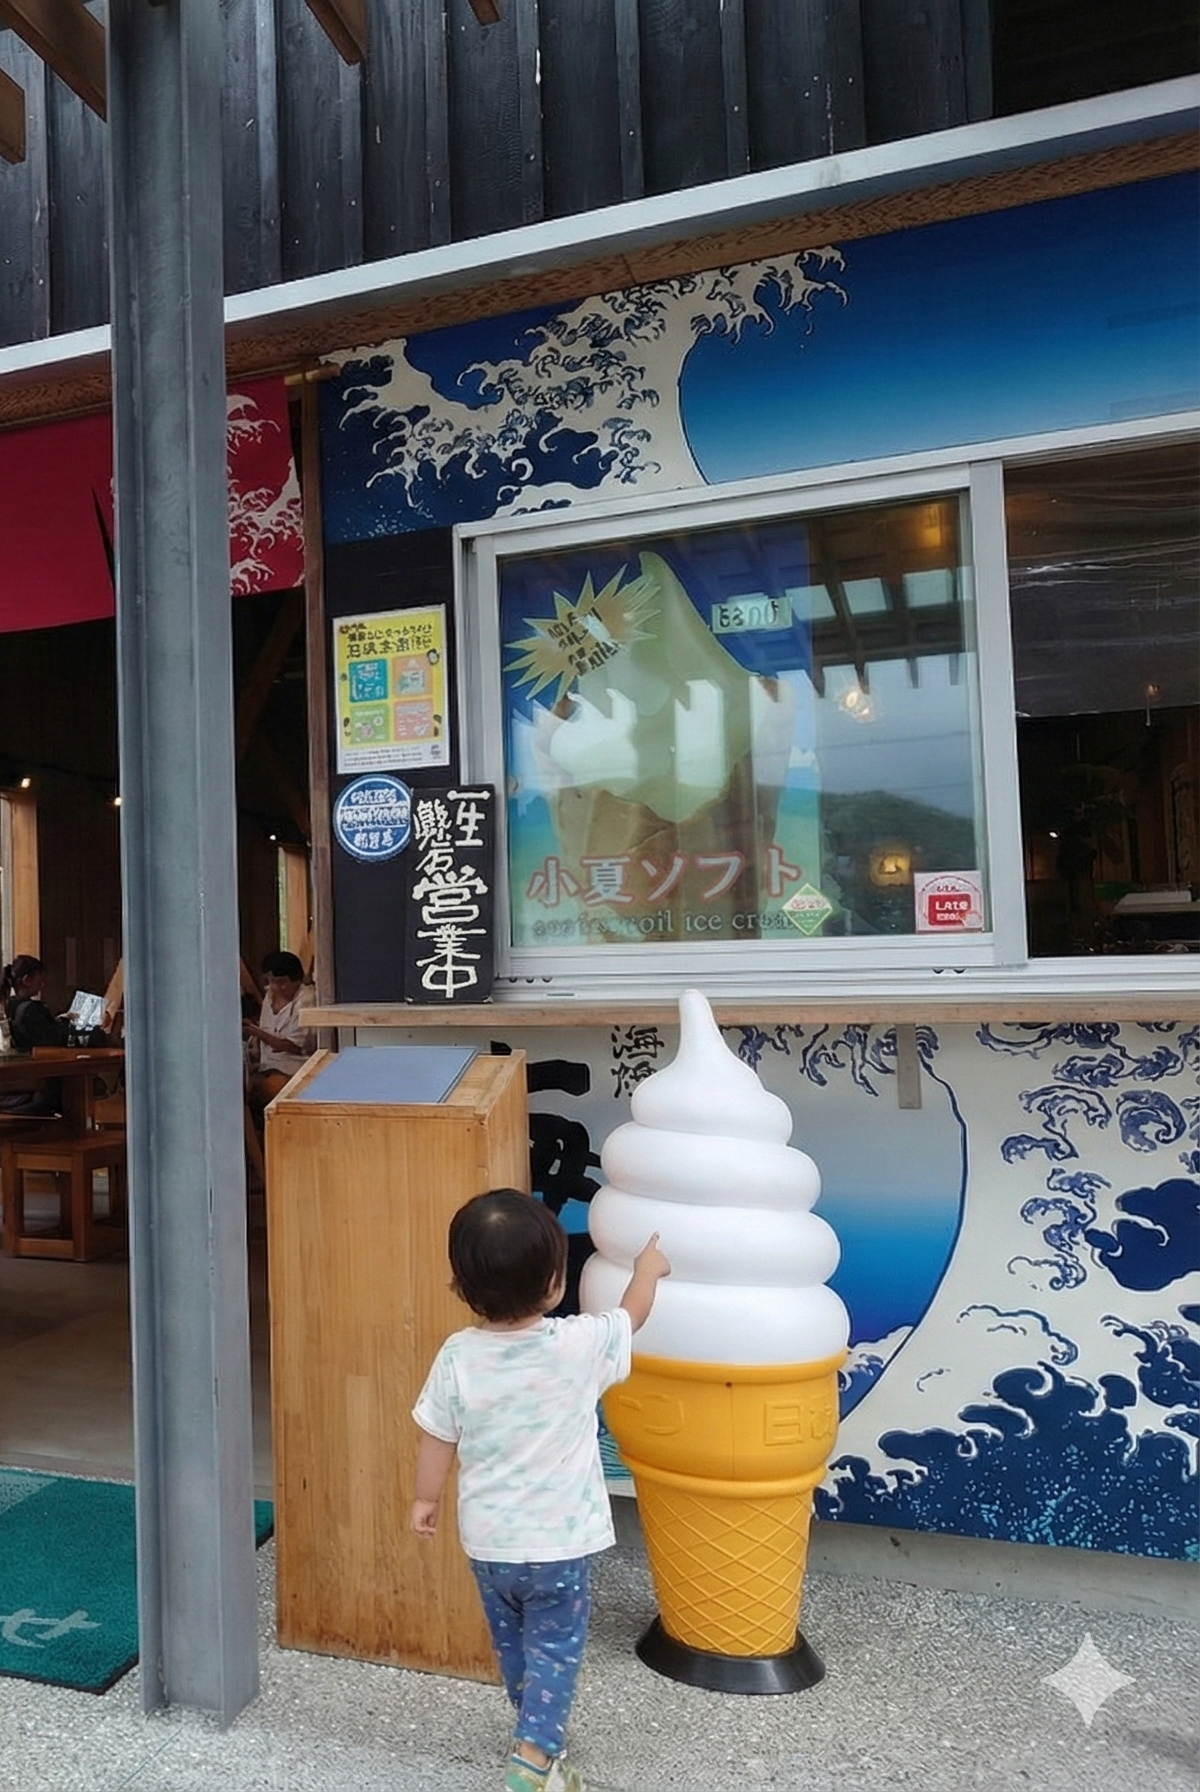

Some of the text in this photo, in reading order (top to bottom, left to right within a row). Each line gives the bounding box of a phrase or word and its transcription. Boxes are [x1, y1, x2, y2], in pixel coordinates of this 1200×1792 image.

[525, 845, 802, 908] 小夏ソフト
[684, 914, 722, 931] ice
